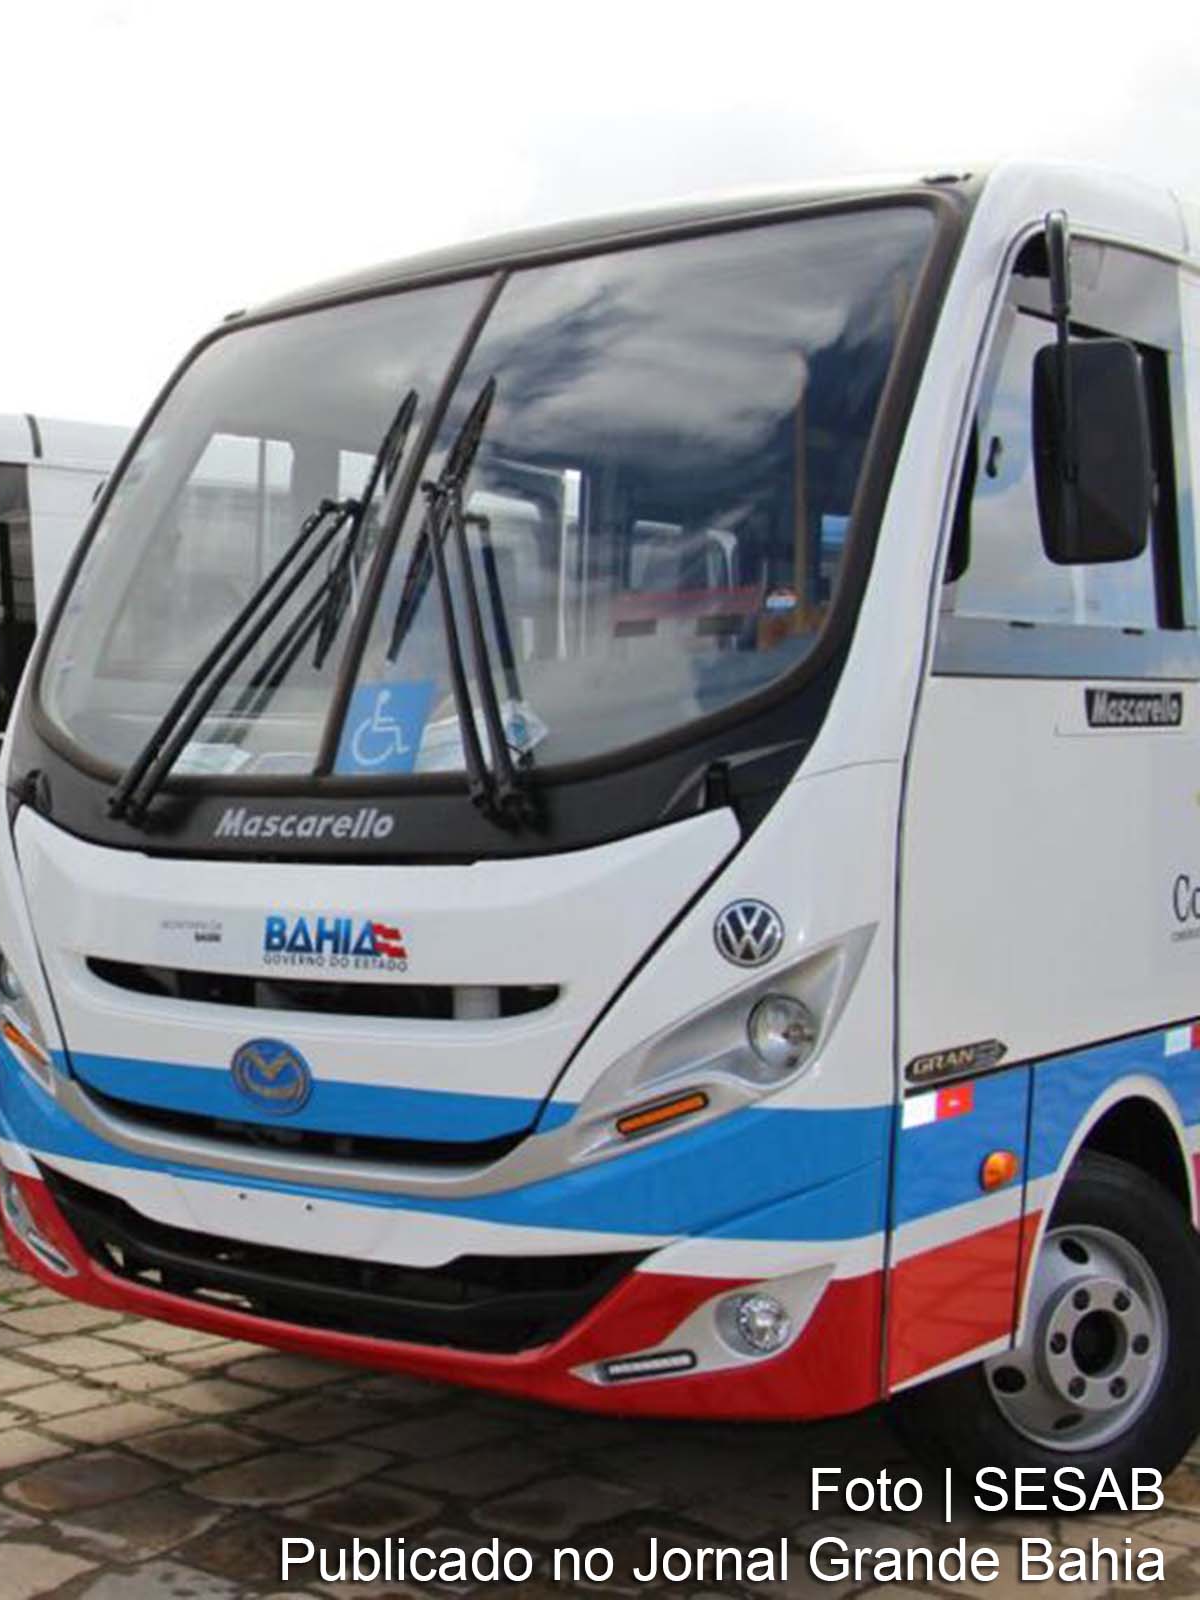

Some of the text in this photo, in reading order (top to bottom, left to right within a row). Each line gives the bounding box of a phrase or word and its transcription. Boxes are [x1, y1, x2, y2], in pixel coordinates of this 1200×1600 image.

[1091, 692, 1178, 724] Mascarello
[213, 808, 395, 839] Mascarello
[264, 915, 379, 955] BAHIA
[263, 953, 409, 973] GOVERNO DO ESTADO
[912, 1048, 975, 1076] GRAN
